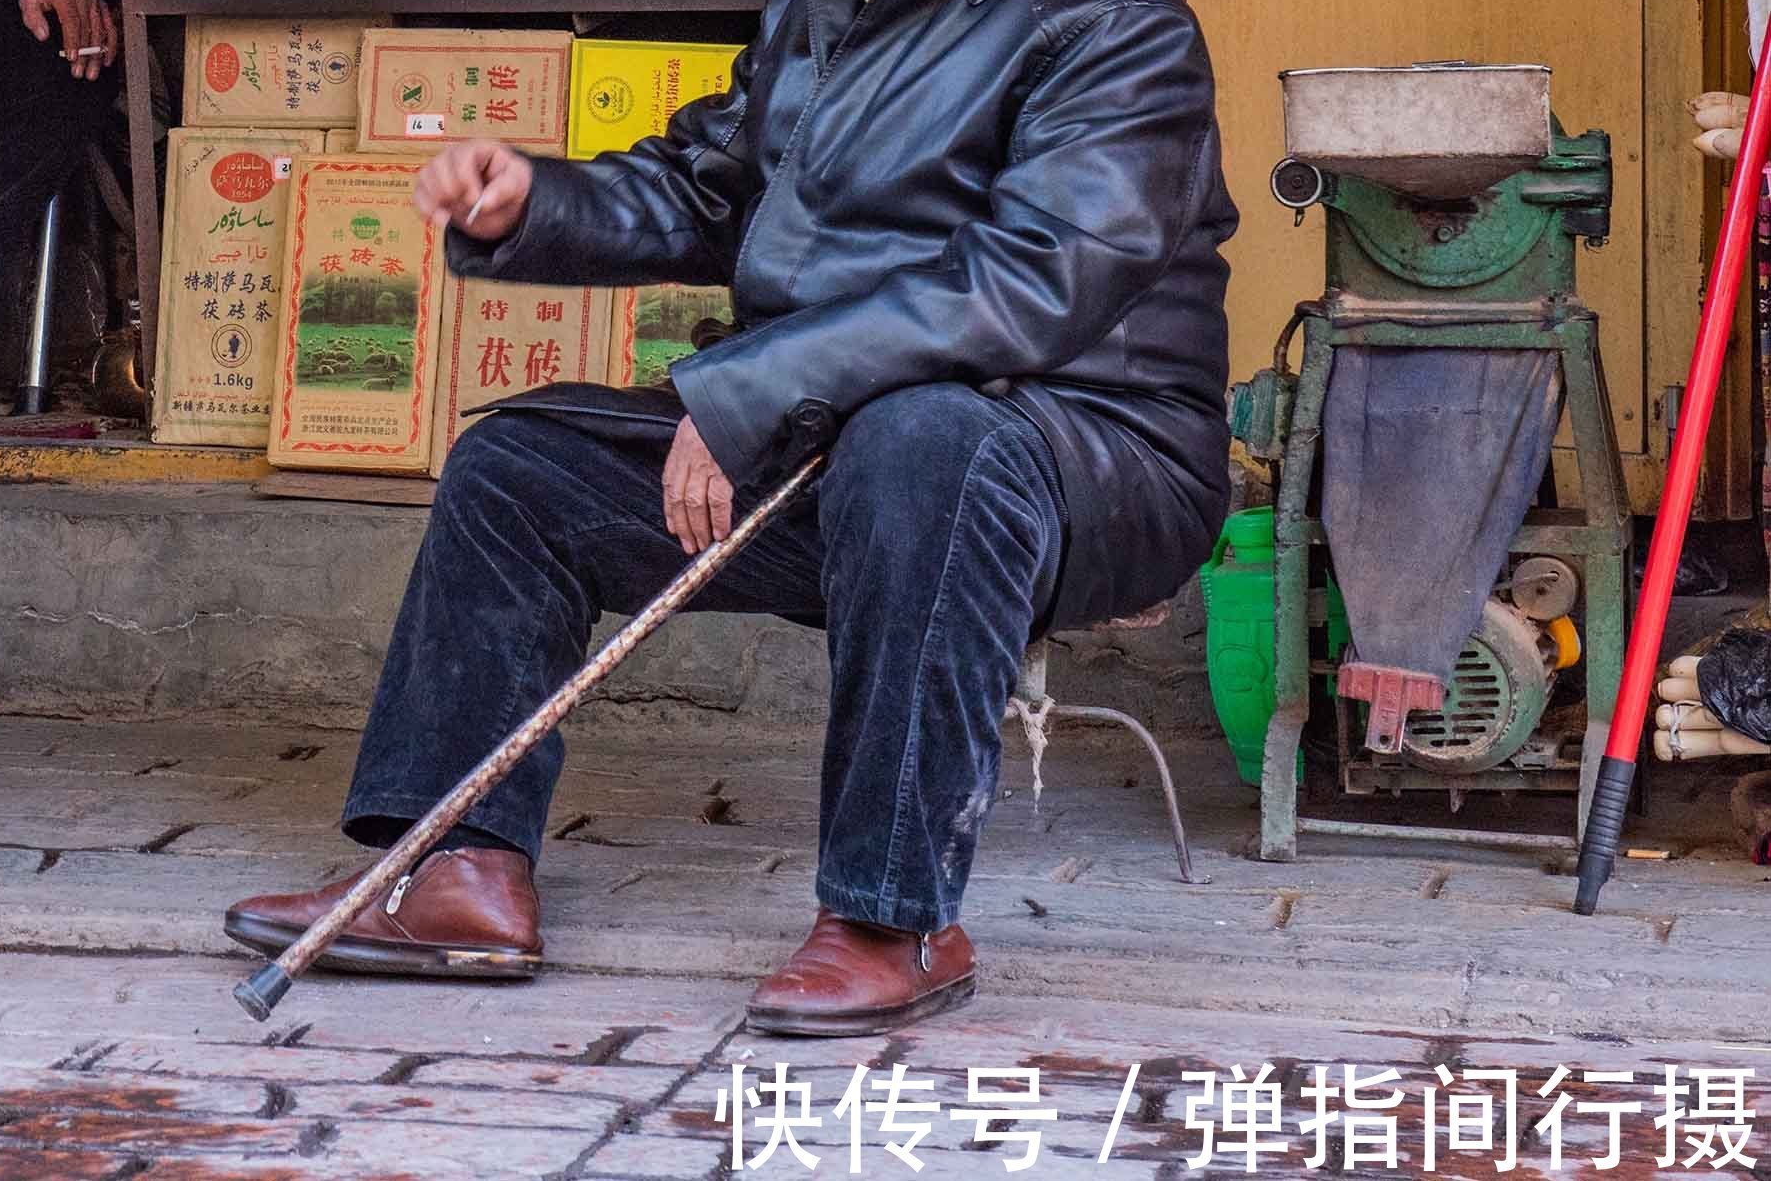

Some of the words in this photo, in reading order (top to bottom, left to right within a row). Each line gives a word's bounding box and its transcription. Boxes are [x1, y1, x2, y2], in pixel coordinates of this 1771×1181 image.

[306, 38, 325, 94] 茯砖茶
[485, 66, 520, 124] 茯砖
[319, 247, 405, 276] 茯砖茶
[184, 271, 281, 294] 特制萨马瓦
[201, 299, 273, 323] 茯砖茶
[480, 299, 564, 323] 特制
[477, 337, 563, 388] 茯砖
[213, 373, 254, 390] 1.6kg
